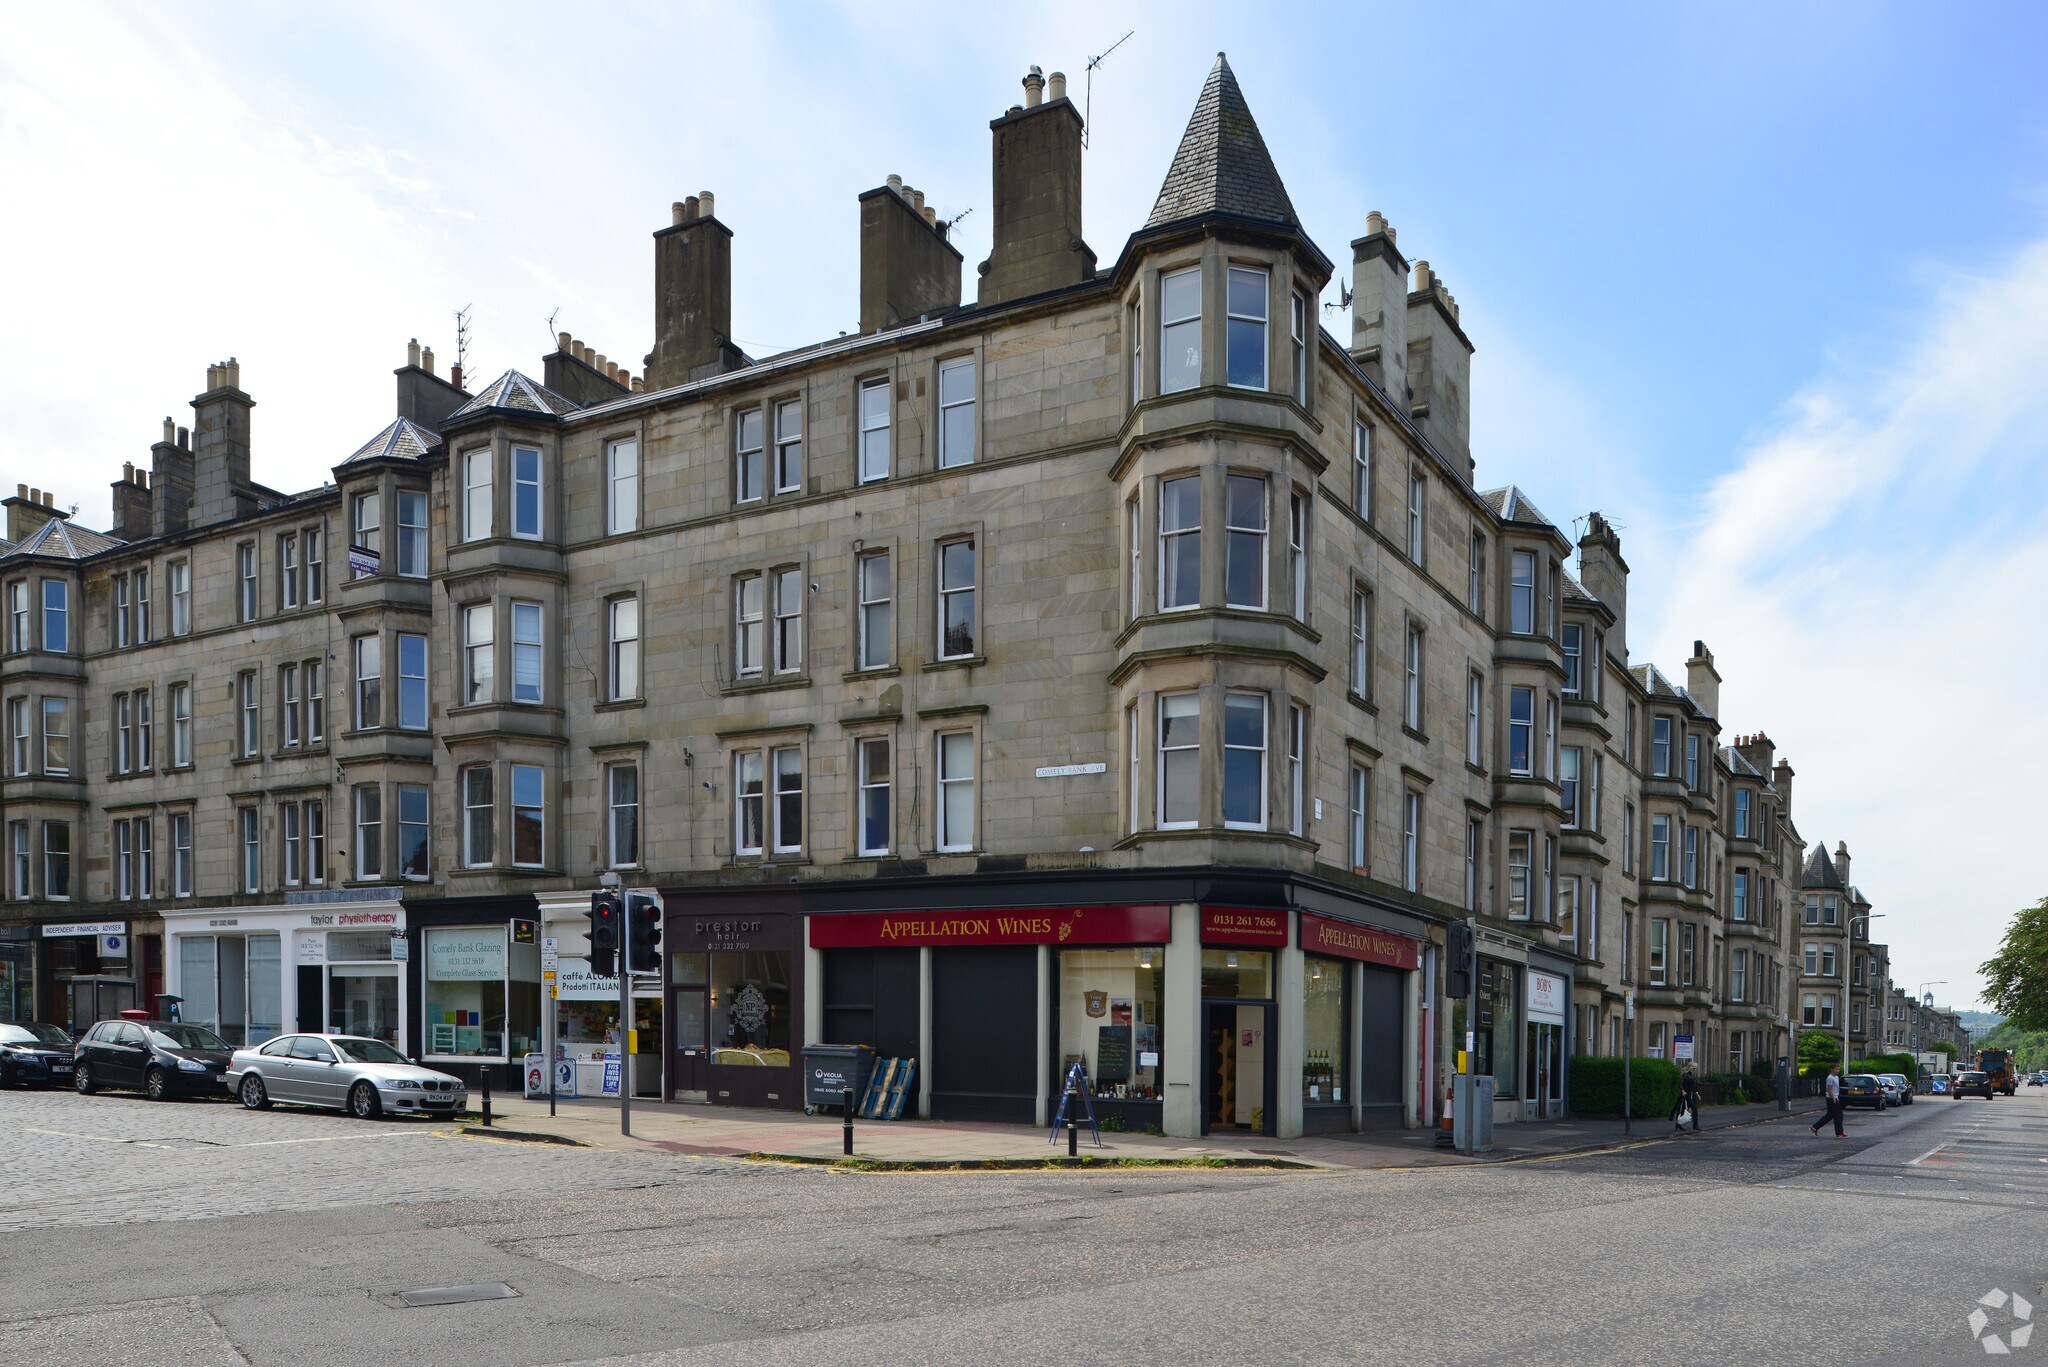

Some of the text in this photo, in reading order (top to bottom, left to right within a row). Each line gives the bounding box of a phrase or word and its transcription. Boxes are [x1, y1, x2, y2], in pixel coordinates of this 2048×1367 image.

[1037, 768, 1065, 776] COMELY
[310, 912, 397, 926] taylor physiotherapy
[1213, 914, 1277, 927] 0131 261 7656
[45, 926, 75, 934] INDEPENDENT
[102, 924, 122, 932] ADVISER
[695, 919, 761, 935] preston
[1206, 927, 1283, 935] www.appellationwines.co.uk
[717, 932, 740, 941] hair
[432, 942, 502, 956] Comely Bank Glazing
[447, 957, 460, 965] 0131
[461, 957, 471, 965] 332
[436, 968, 498, 978] Complete Glass Service
[562, 982, 589, 991] Prodotti
